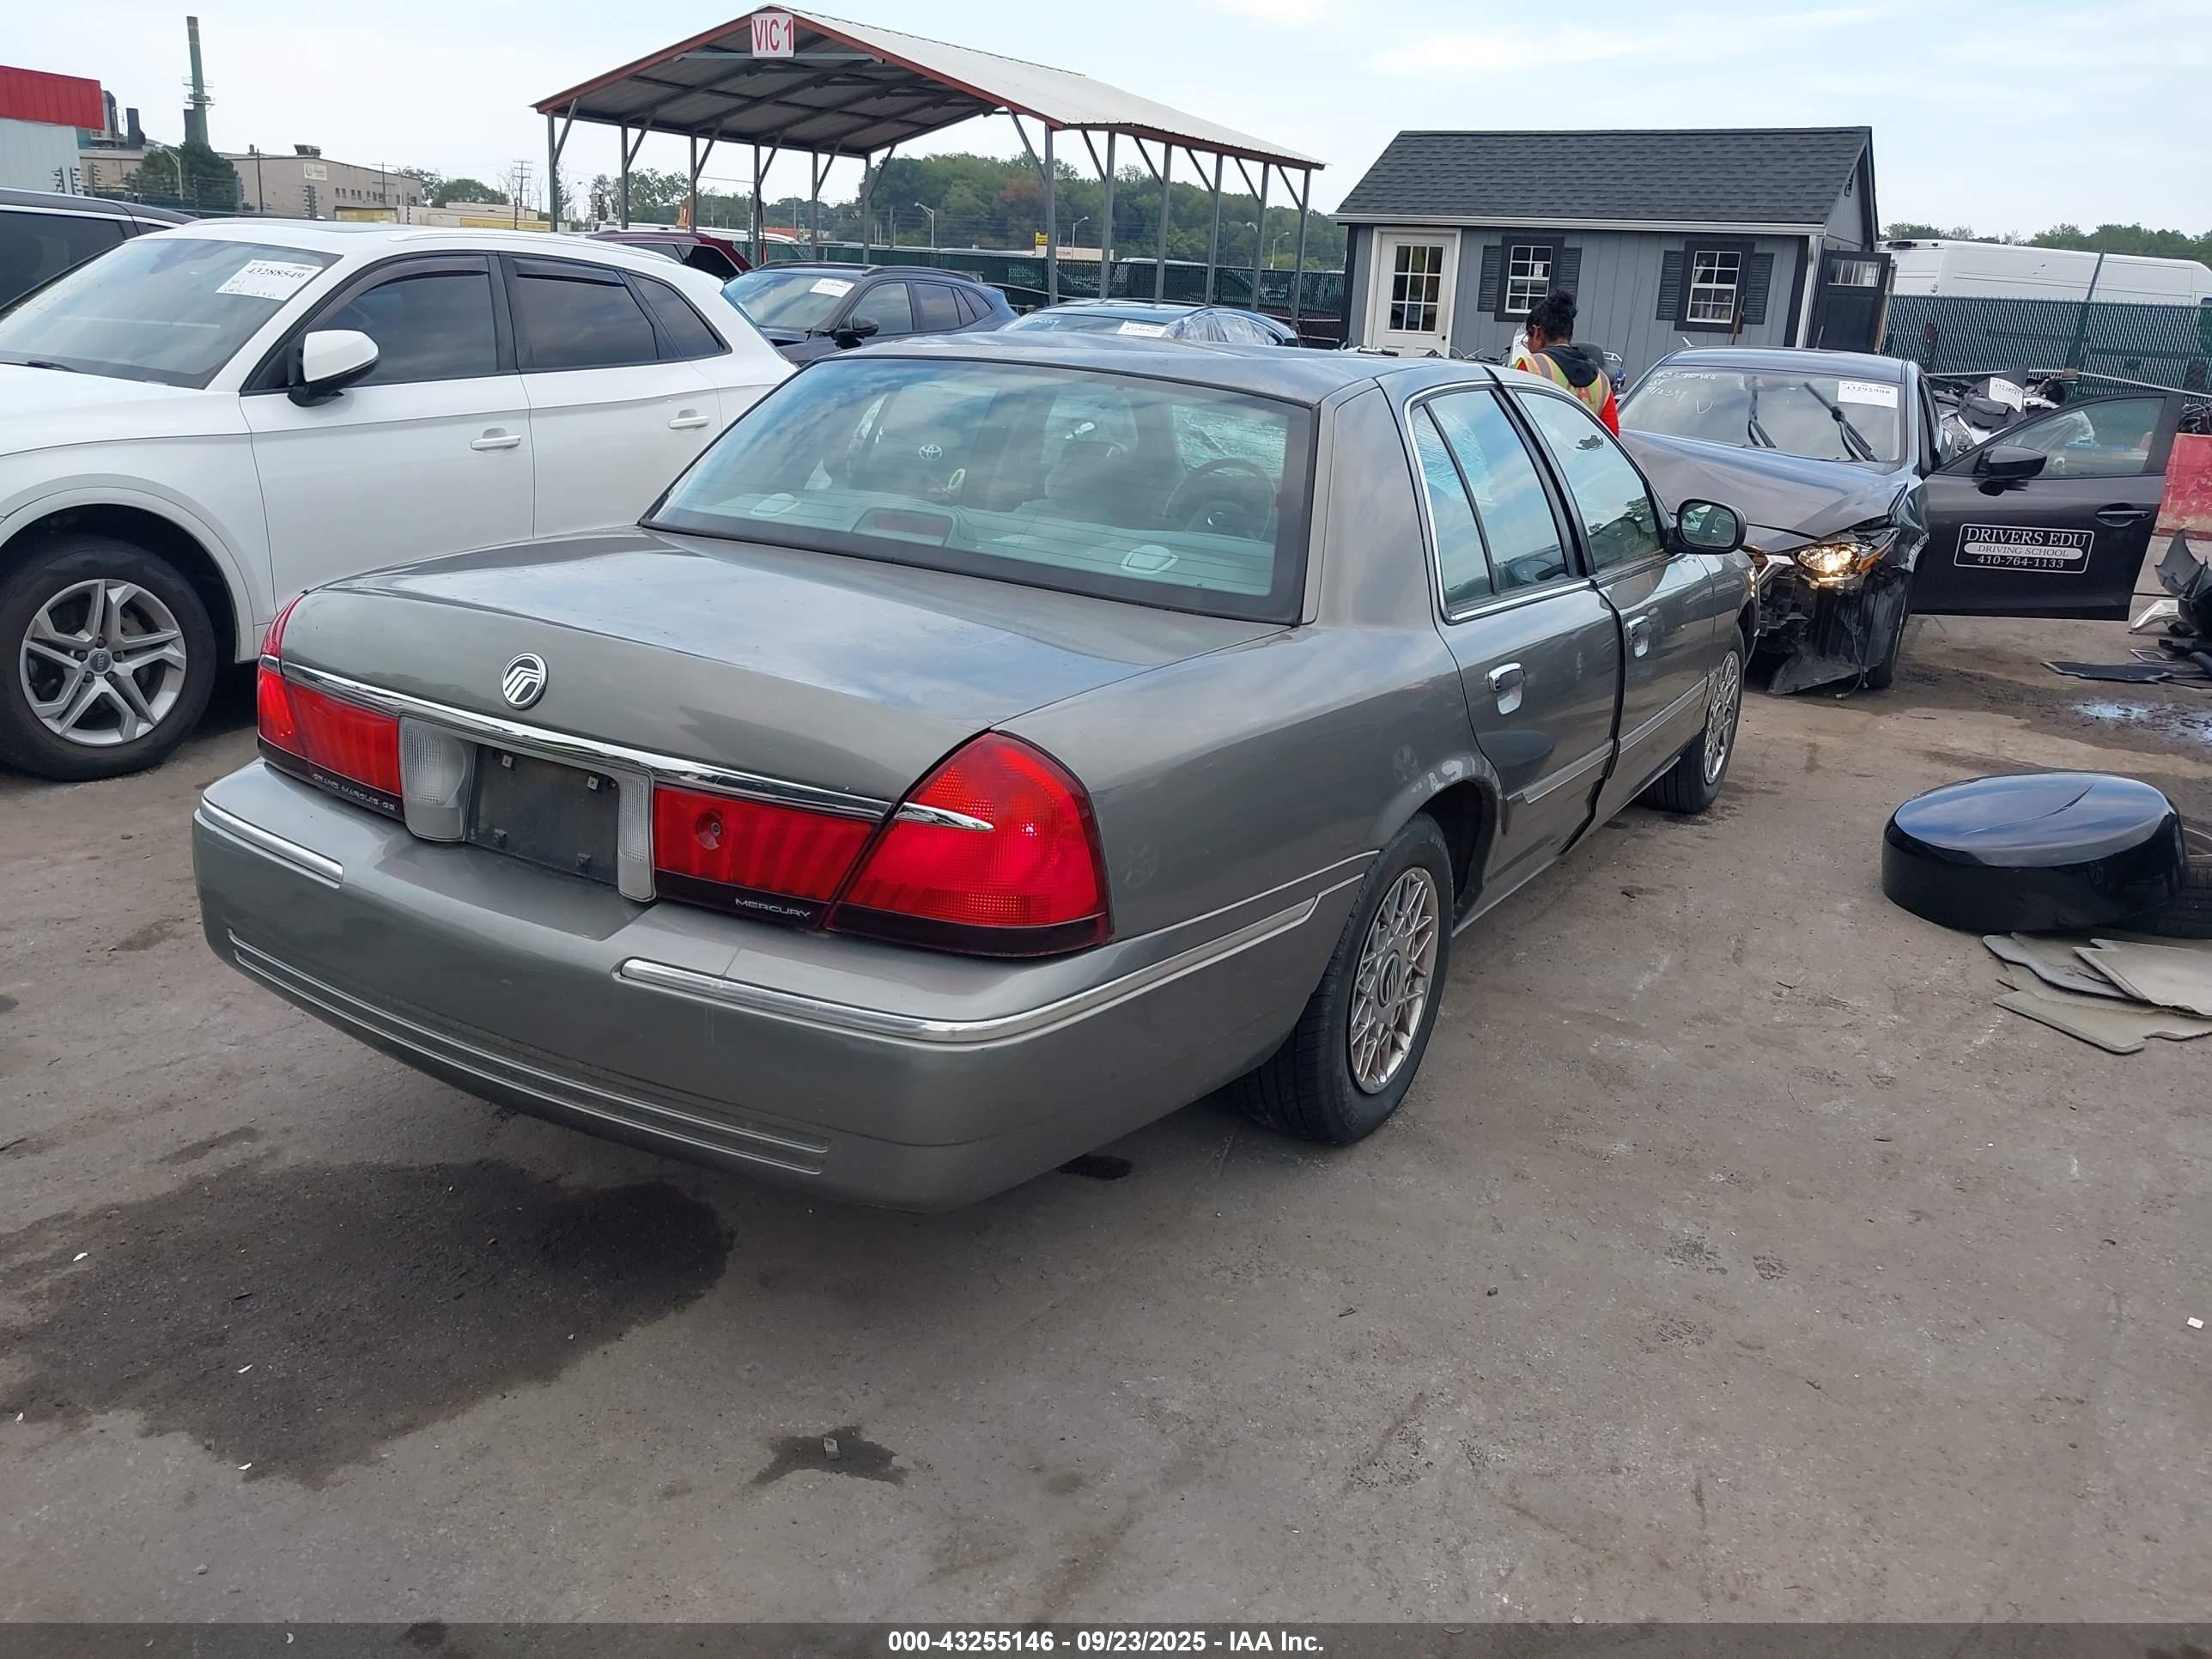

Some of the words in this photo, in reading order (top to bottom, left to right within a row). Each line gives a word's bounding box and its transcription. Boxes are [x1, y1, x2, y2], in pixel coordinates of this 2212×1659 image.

[752, 18, 780, 52] VIC
[783, 18, 792, 52] 1
[246, 266, 306, 280] 43288549
[1966, 528, 2044, 545] DRIVERS
[2048, 532, 2087, 547] EDU
[1978, 545, 2022, 555] DRIVING
[2025, 547, 2069, 557] SCHOOL
[1978, 556, 2064, 568] 410-764-1133
[735, 897, 811, 918] MERCURY
